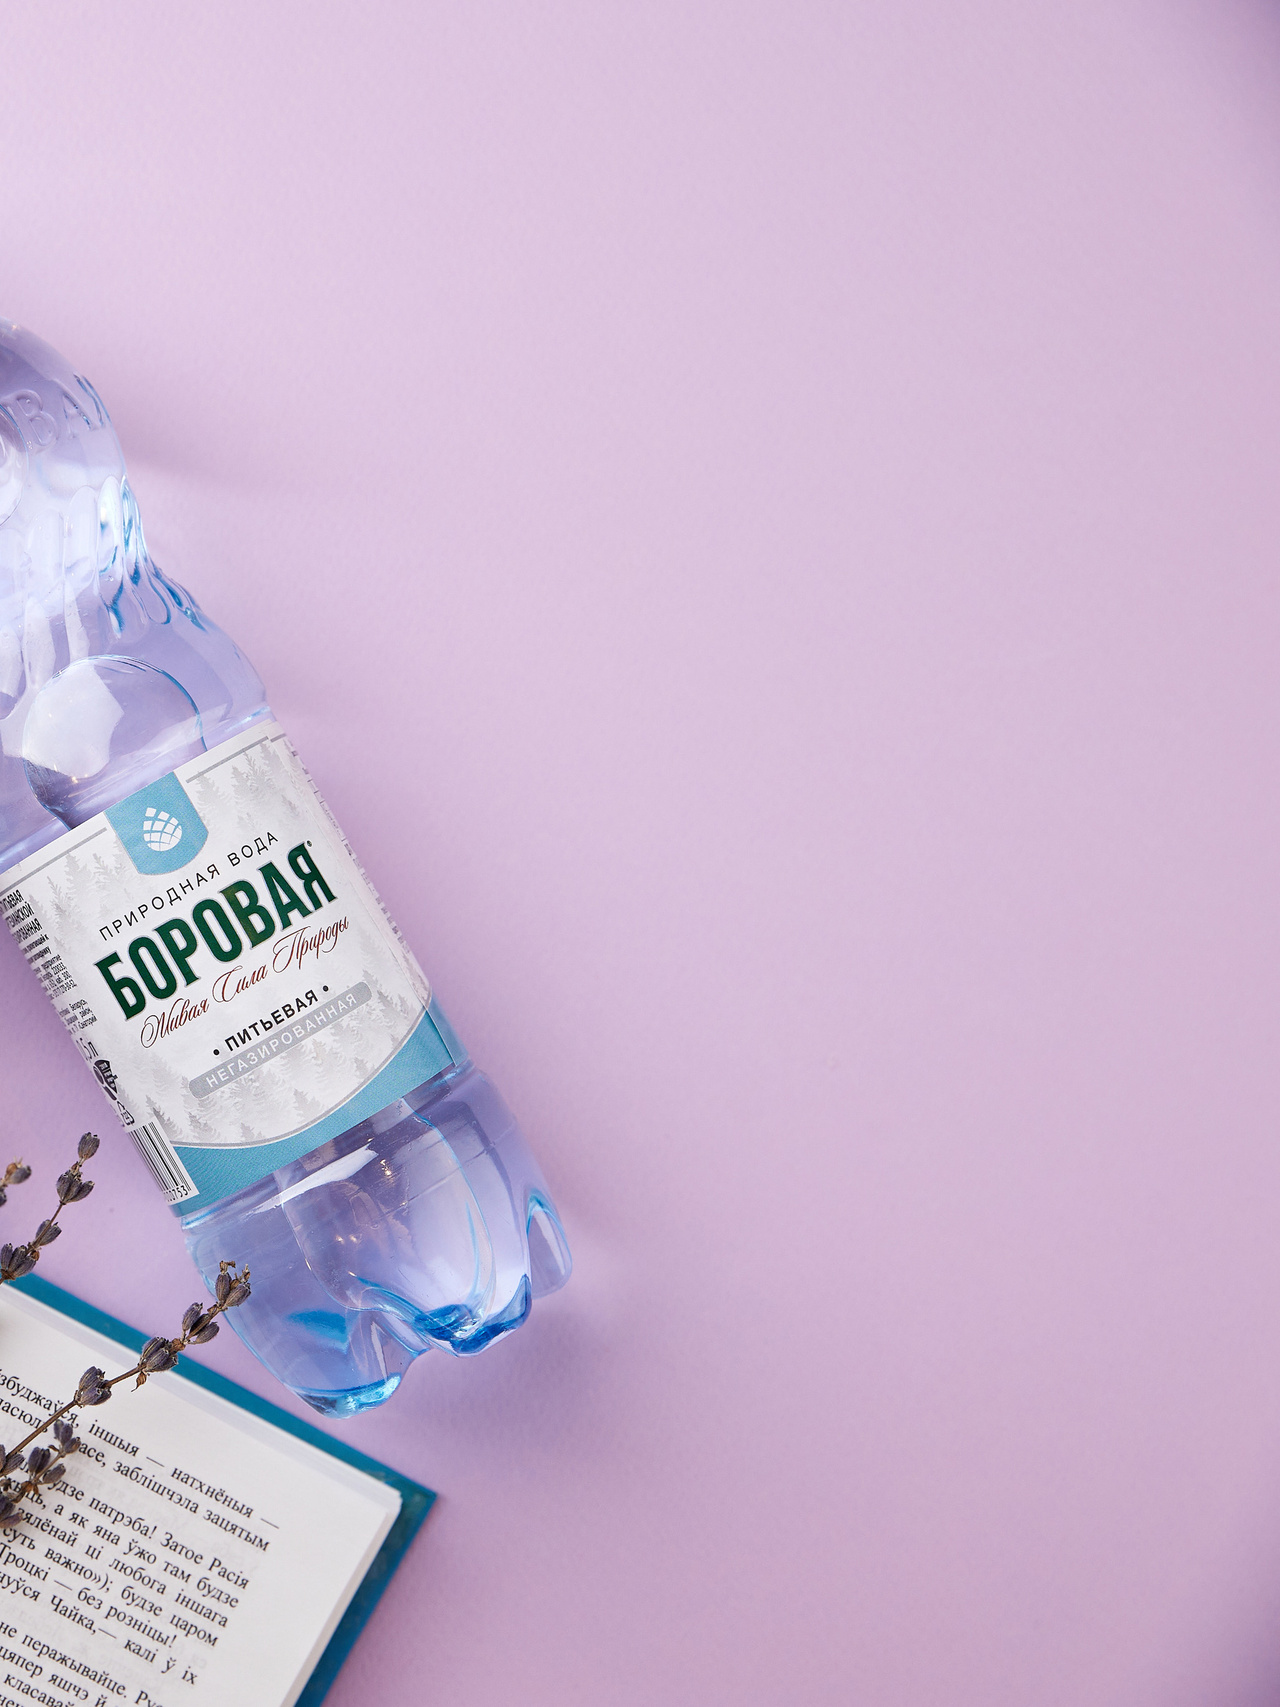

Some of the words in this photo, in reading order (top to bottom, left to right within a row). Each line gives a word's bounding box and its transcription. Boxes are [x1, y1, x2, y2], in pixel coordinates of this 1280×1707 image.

[99, 864, 219, 940] ПРИРОДНАЯ
[227, 832, 278, 866] ВОДА
[95, 848, 337, 1021] БОРОВАЯ
[140, 998, 209, 1048] Живая
[212, 965, 267, 1002] Сила
[272, 916, 348, 973] Природы
[224, 989, 318, 1051] ПИТЬЕВАЯ
[206, 993, 357, 1088] НЕГАЗИРОВАННАЯ
[88, 1419, 139, 1456] іншыя
[171, 1468, 253, 1517] натхнёныя
[113, 1461, 198, 1513] заблішчэла
[206, 1510, 268, 1550] зацятым
[54, 1504, 63, 1515] а
[69, 1512, 88, 1528] як
[93, 1525, 120, 1545] яна
[123, 1539, 156, 1563] ўжо
[164, 1562, 190, 1582] там
[197, 1577, 238, 1607] будзе
[89, 1498, 157, 1538] патрэба!
[161, 1532, 202, 1564] Затое
[208, 1558, 248, 1588] Расія
[90, 1546, 103, 1559] ці
[109, 1559, 166, 1594] любога
[175, 1589, 227, 1626] іншага
[45, 1548, 112, 1591] важно»);
[121, 1586, 162, 1616] будзе
[170, 1615, 217, 1645] царом
[78, 1587, 102, 1609] без
[105, 1606, 176, 1647] розніцы!
[22, 1635, 125, 1695] перажывайце.
[48, 1674, 88, 1700] яшчэ
[124, 1640, 155, 1662] калі
[161, 1658, 176, 1673] ў
[182, 1666, 198, 1685] іх
